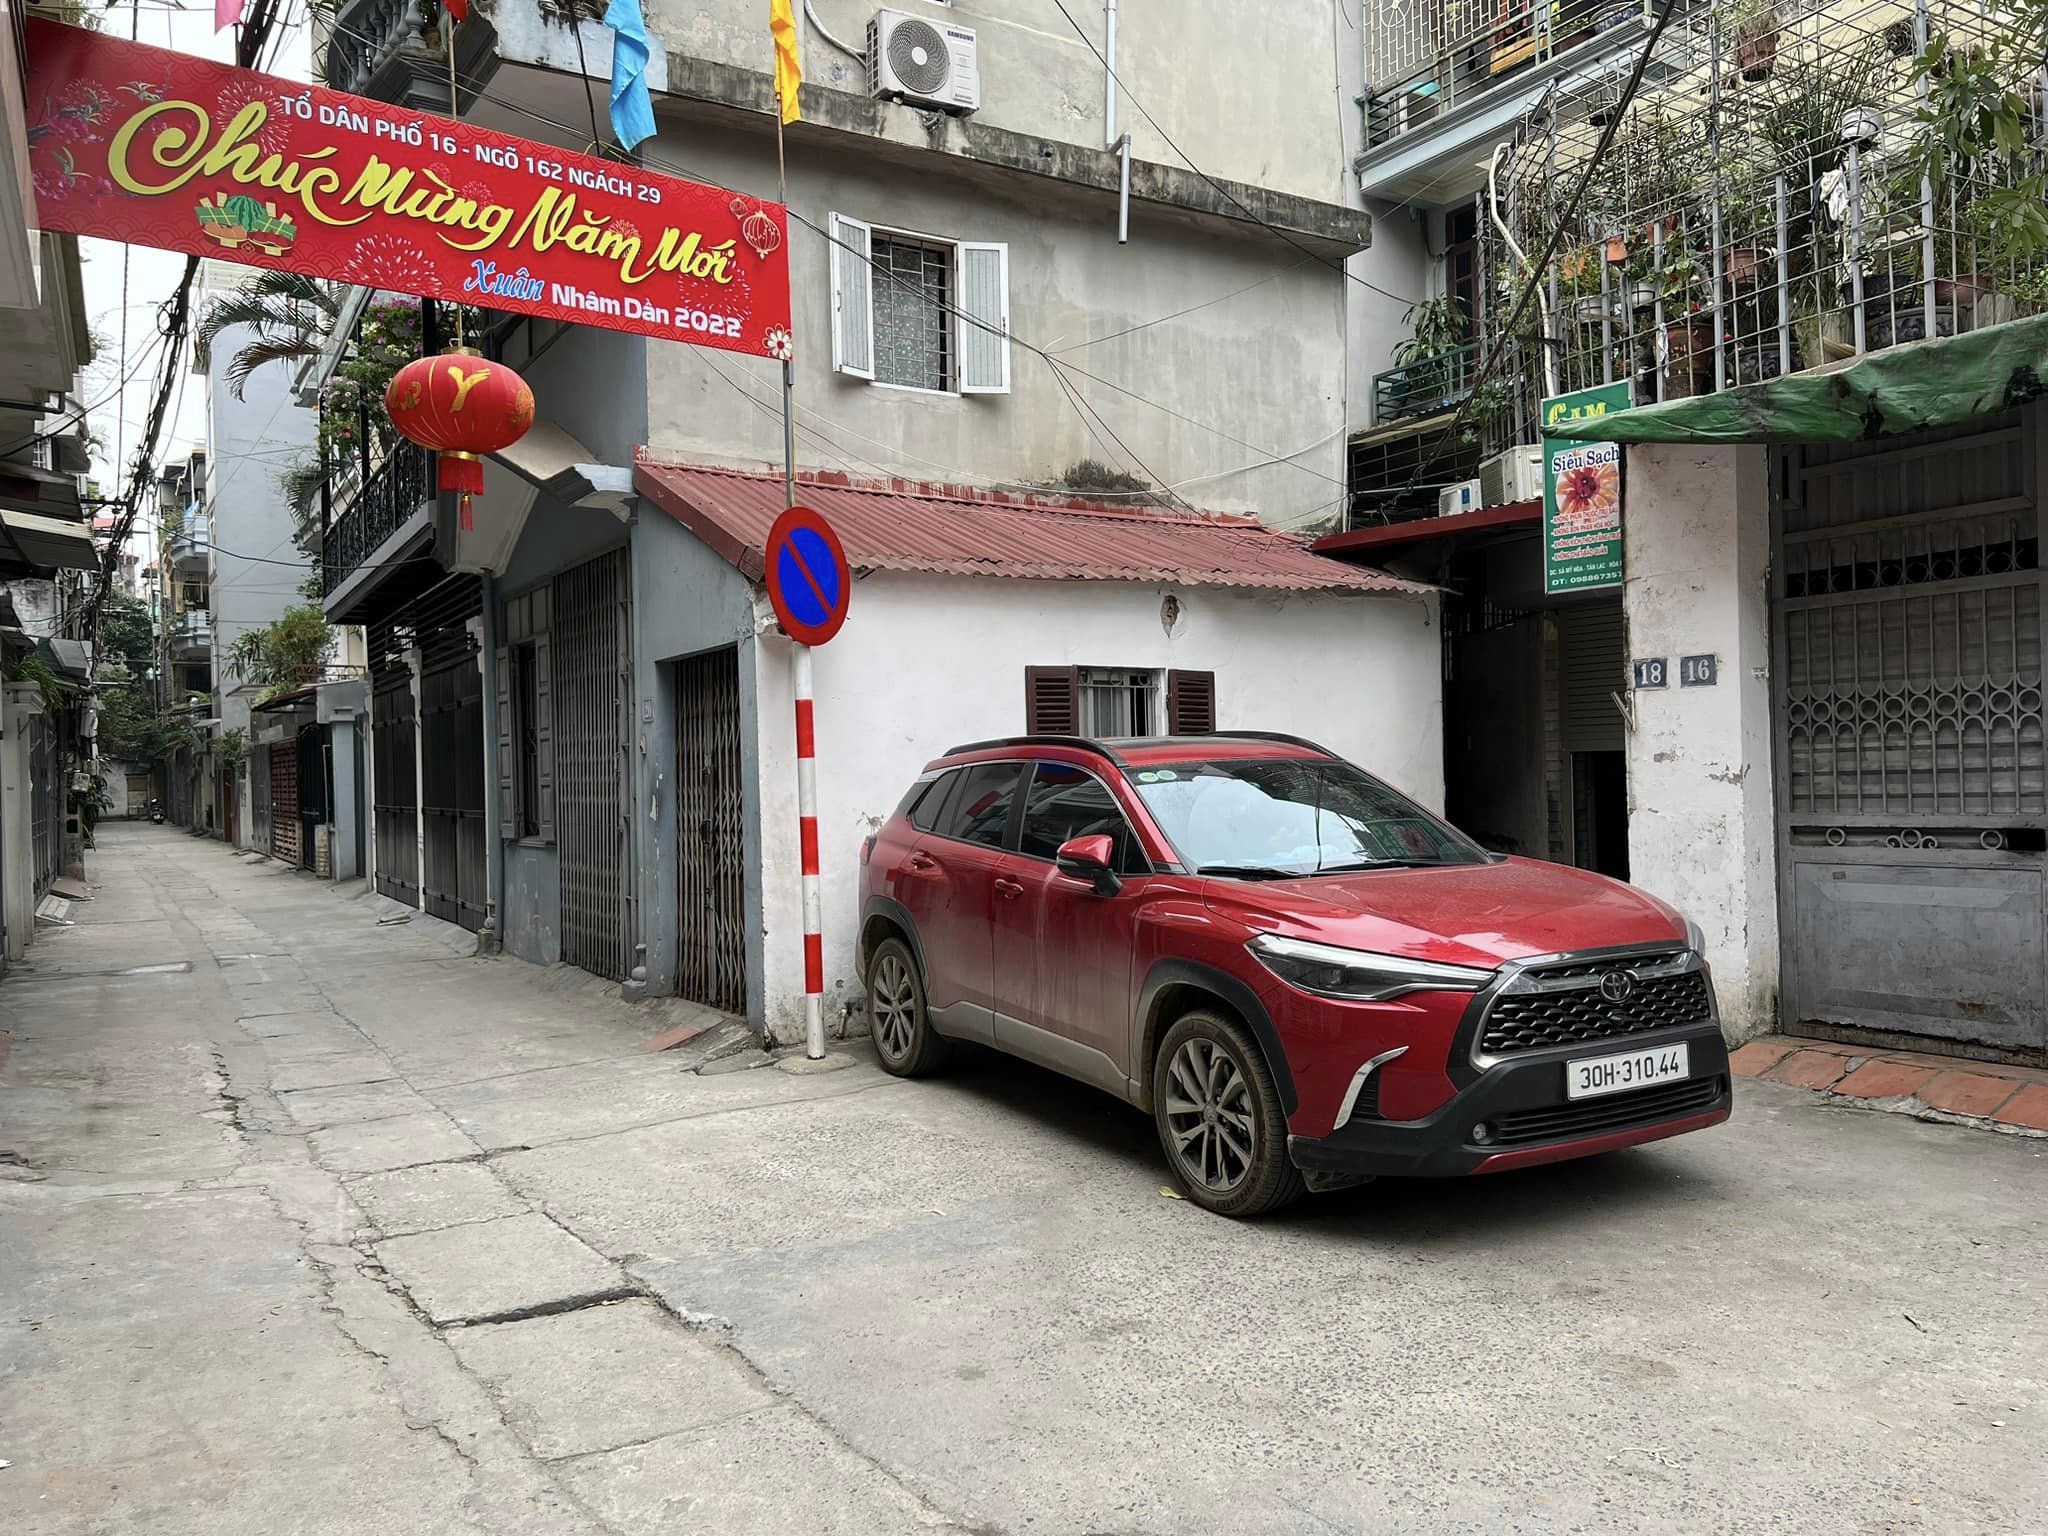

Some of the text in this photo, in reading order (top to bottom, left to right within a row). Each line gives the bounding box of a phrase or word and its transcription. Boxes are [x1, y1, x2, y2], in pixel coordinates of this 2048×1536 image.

[280, 90, 313, 120] TỔ
[319, 105, 369, 134] DÂN
[375, 120, 424, 146] PHỐ
[430, 133, 457, 155] 16
[475, 143, 519, 169] NGÕ
[525, 157, 563, 181] 162
[568, 167, 632, 198] NGÁCH
[637, 184, 661, 204] 29
[108, 100, 738, 285] Chúc Mừng Năm Mới
[464, 258, 743, 338] Xuân Nhâm Dần 2022
[1553, 446, 1620, 473] Siêu Sạch
[1641, 663, 1661, 684] 18
[1687, 659, 1710, 682] 16
[1579, 1051, 1680, 1089] 30H-310.44
